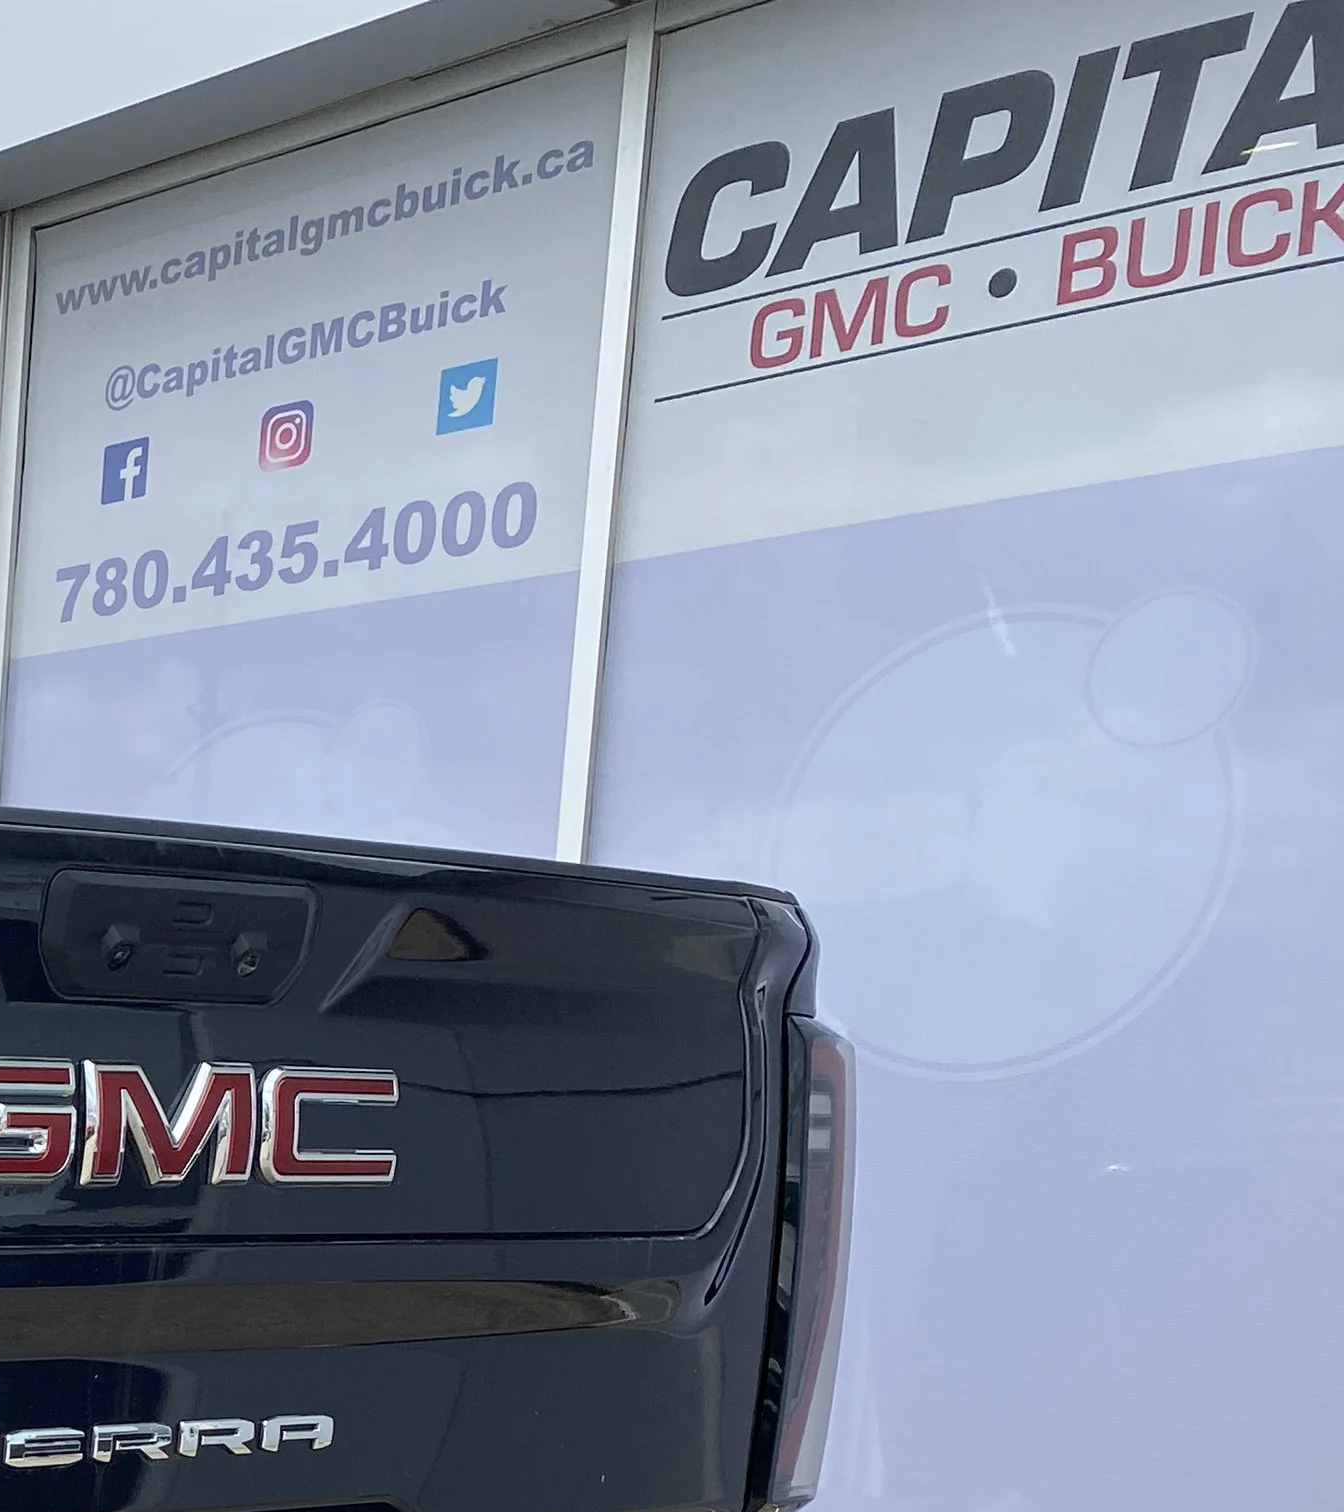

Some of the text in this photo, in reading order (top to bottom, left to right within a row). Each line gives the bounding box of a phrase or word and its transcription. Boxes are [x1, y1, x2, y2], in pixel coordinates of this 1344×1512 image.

[55, 138, 596, 317] www.capitalgmcbuick.ca
[664, 0, 1344, 298] CAPITA
[104, 279, 509, 412] @CapitalGMCBuick
[749, 179, 1344, 370] GMC BUICK
[55, 480, 539, 624] 780.435.4000
